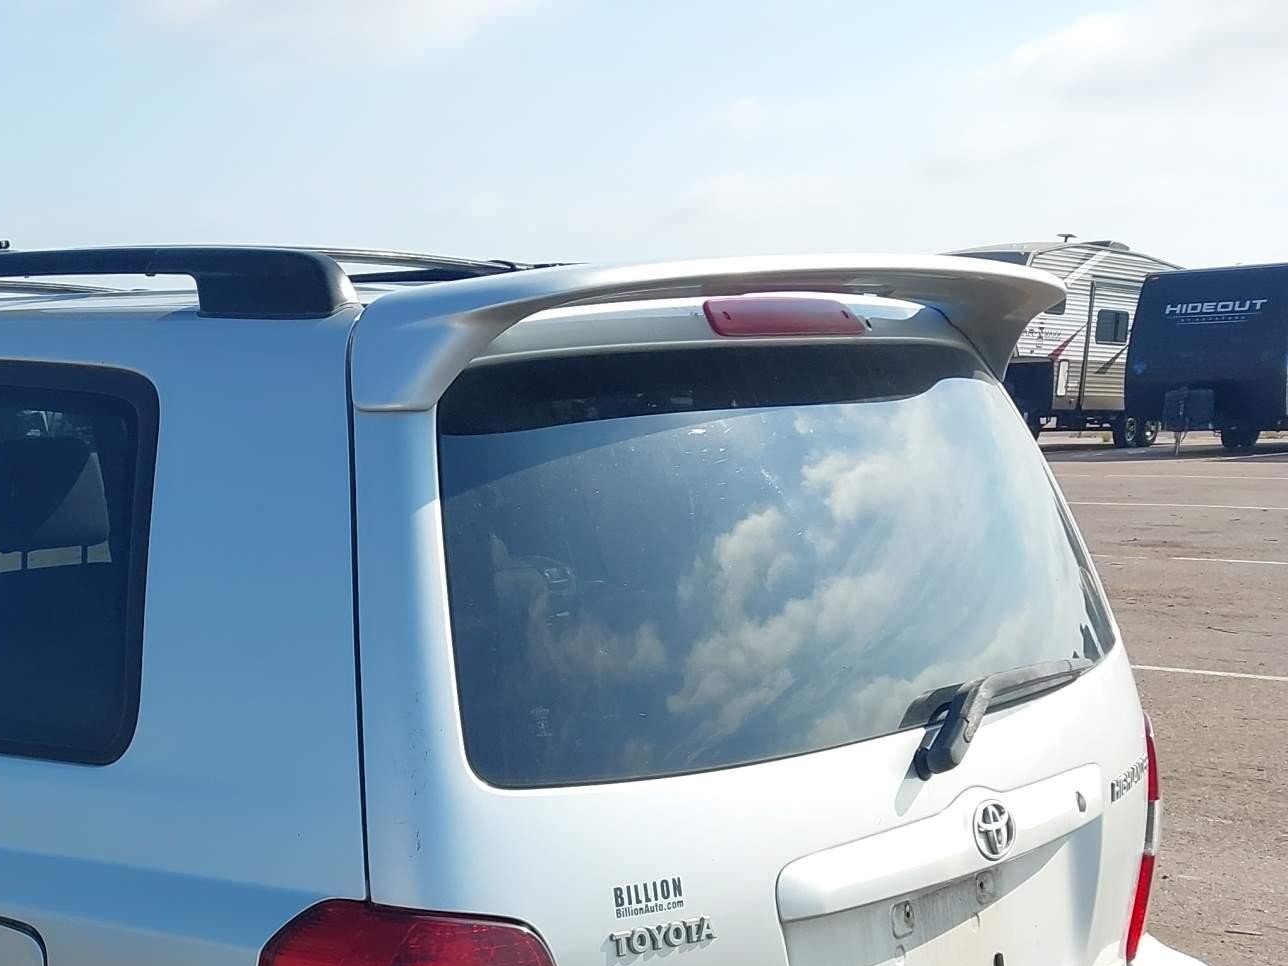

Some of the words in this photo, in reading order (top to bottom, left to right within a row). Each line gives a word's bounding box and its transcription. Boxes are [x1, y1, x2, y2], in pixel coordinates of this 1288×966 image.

[1165, 299, 1268, 314] HIDEOUT
[613, 876, 683, 908] BILLION
[615, 899, 684, 919] BillionAuto.com
[609, 915, 718, 957] TOYOTA
